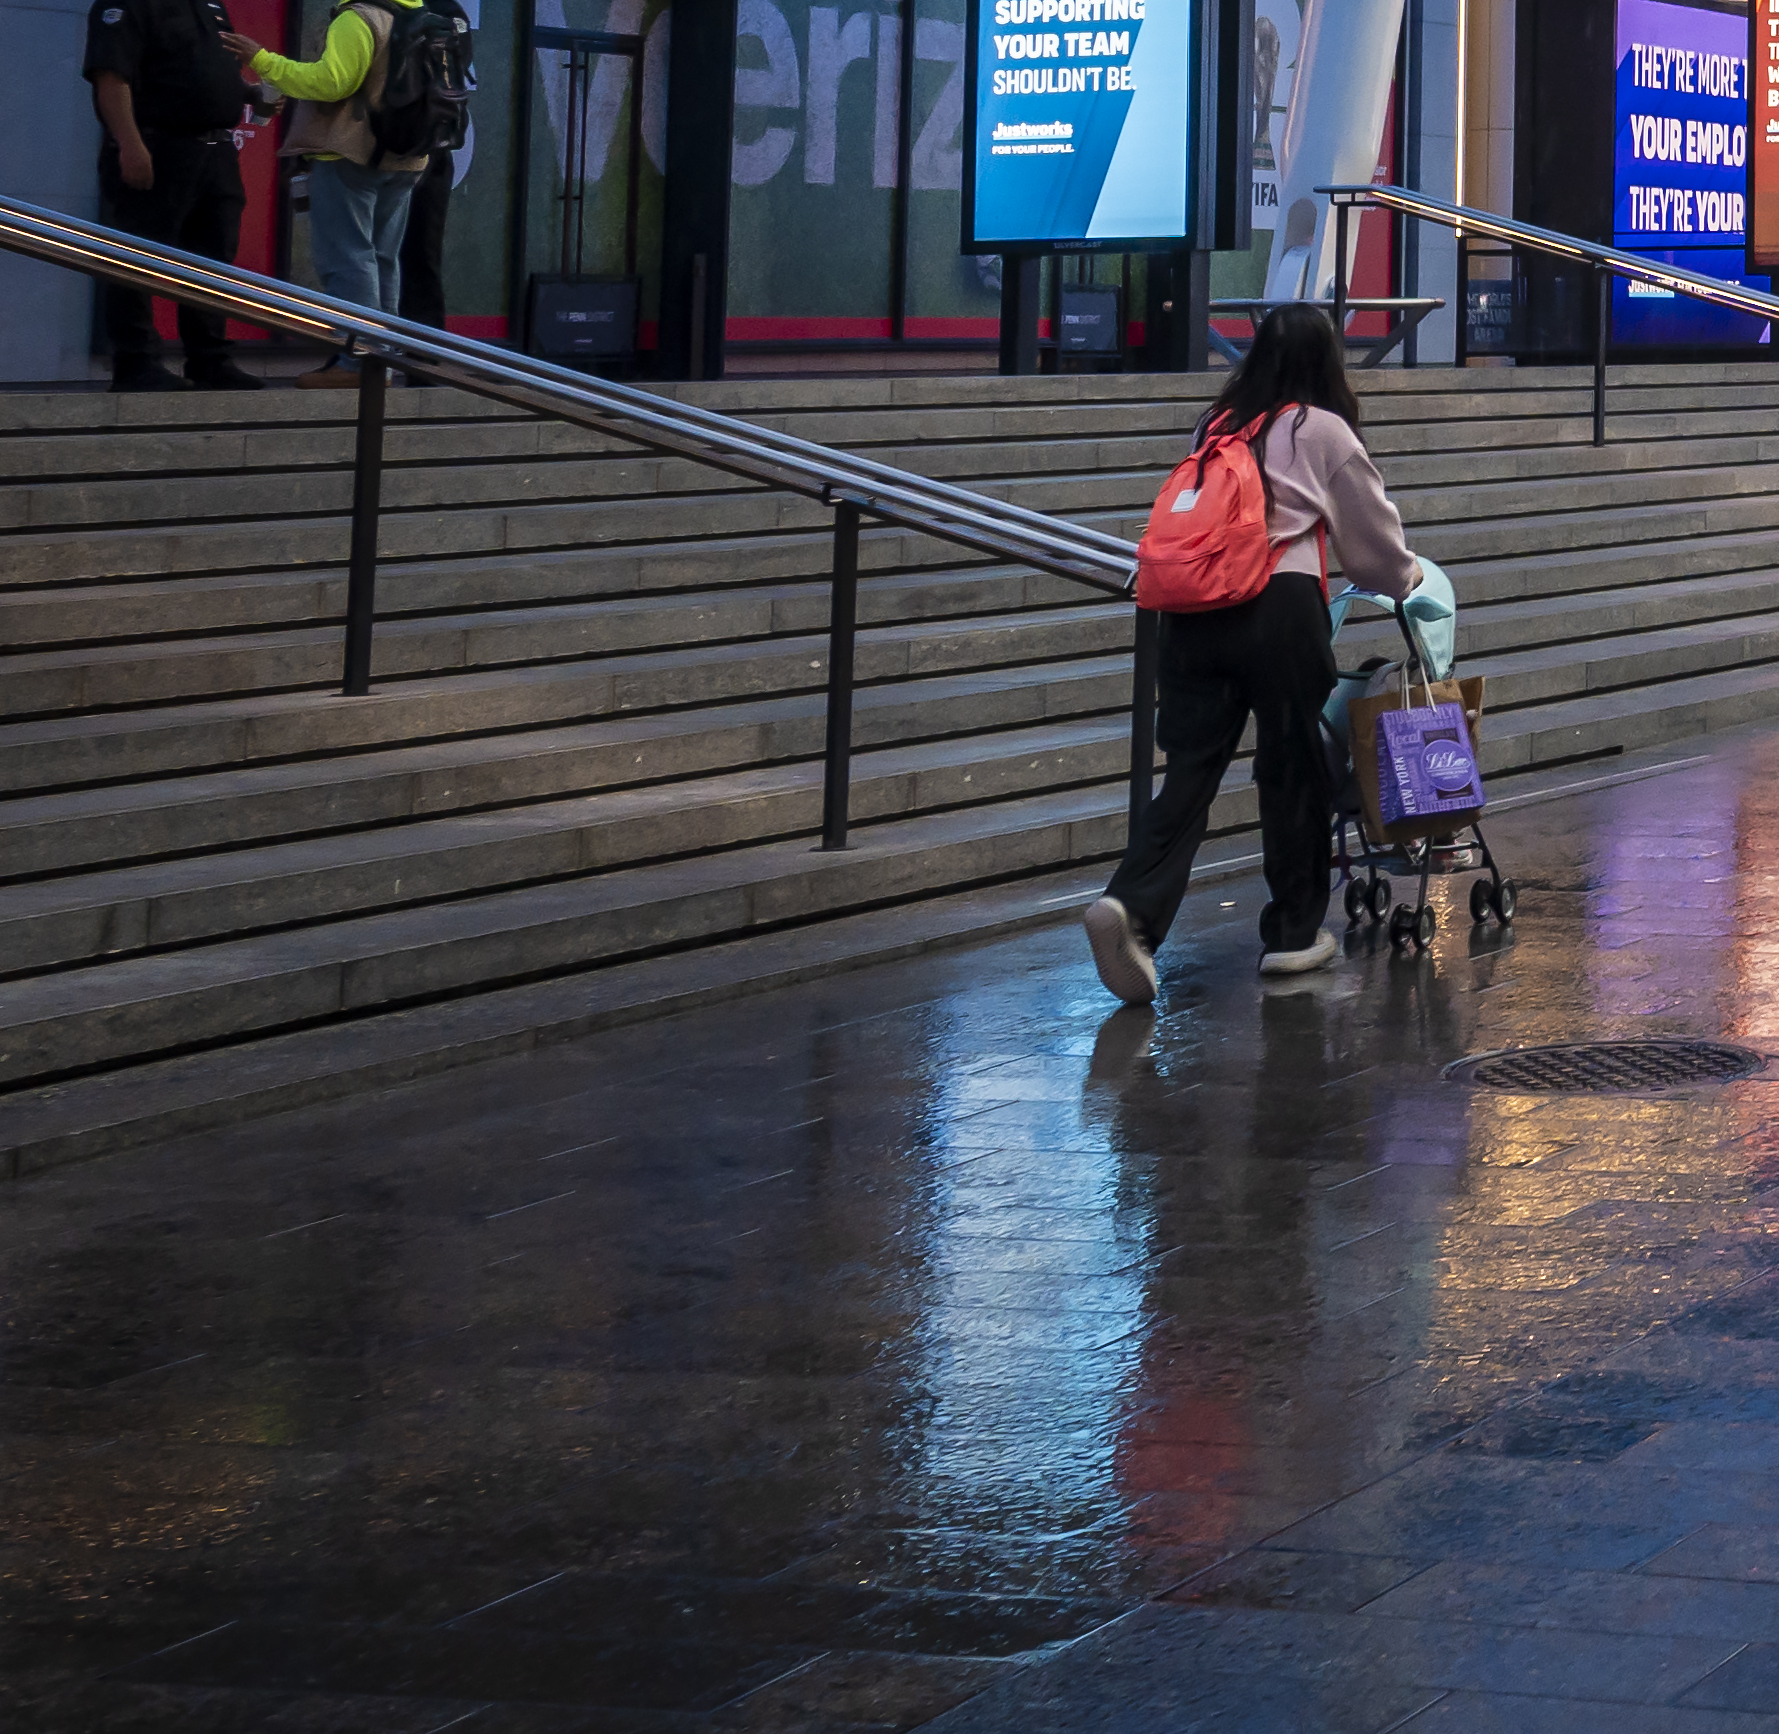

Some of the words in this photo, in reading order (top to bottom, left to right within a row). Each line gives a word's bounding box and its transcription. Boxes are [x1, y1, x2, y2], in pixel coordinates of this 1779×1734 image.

[994, 34, 1059, 59] YOUR
[1064, 31, 1129, 56] TEAM
[993, 68, 1103, 95] SHOULDN'T
[1107, 66, 1137, 91] BE.
[1632, 43, 1694, 93] THEY'RE
[1698, 53, 1739, 98] MORE
[992, 121, 1073, 137] Justworks
[1631, 114, 1681, 162] YOUR
[1686, 120, 1747, 167] EMPLO
[992, 145, 1011, 154] FOR
[1011, 145, 1037, 154] YOUR
[1038, 144, 1075, 154] PEOPLE.
[1630, 186, 1693, 231] THEY'RE
[1696, 191, 1744, 231] YOUR
[1394, 757, 1411, 786] YORK
[1401, 788, 1417, 815] NEW
